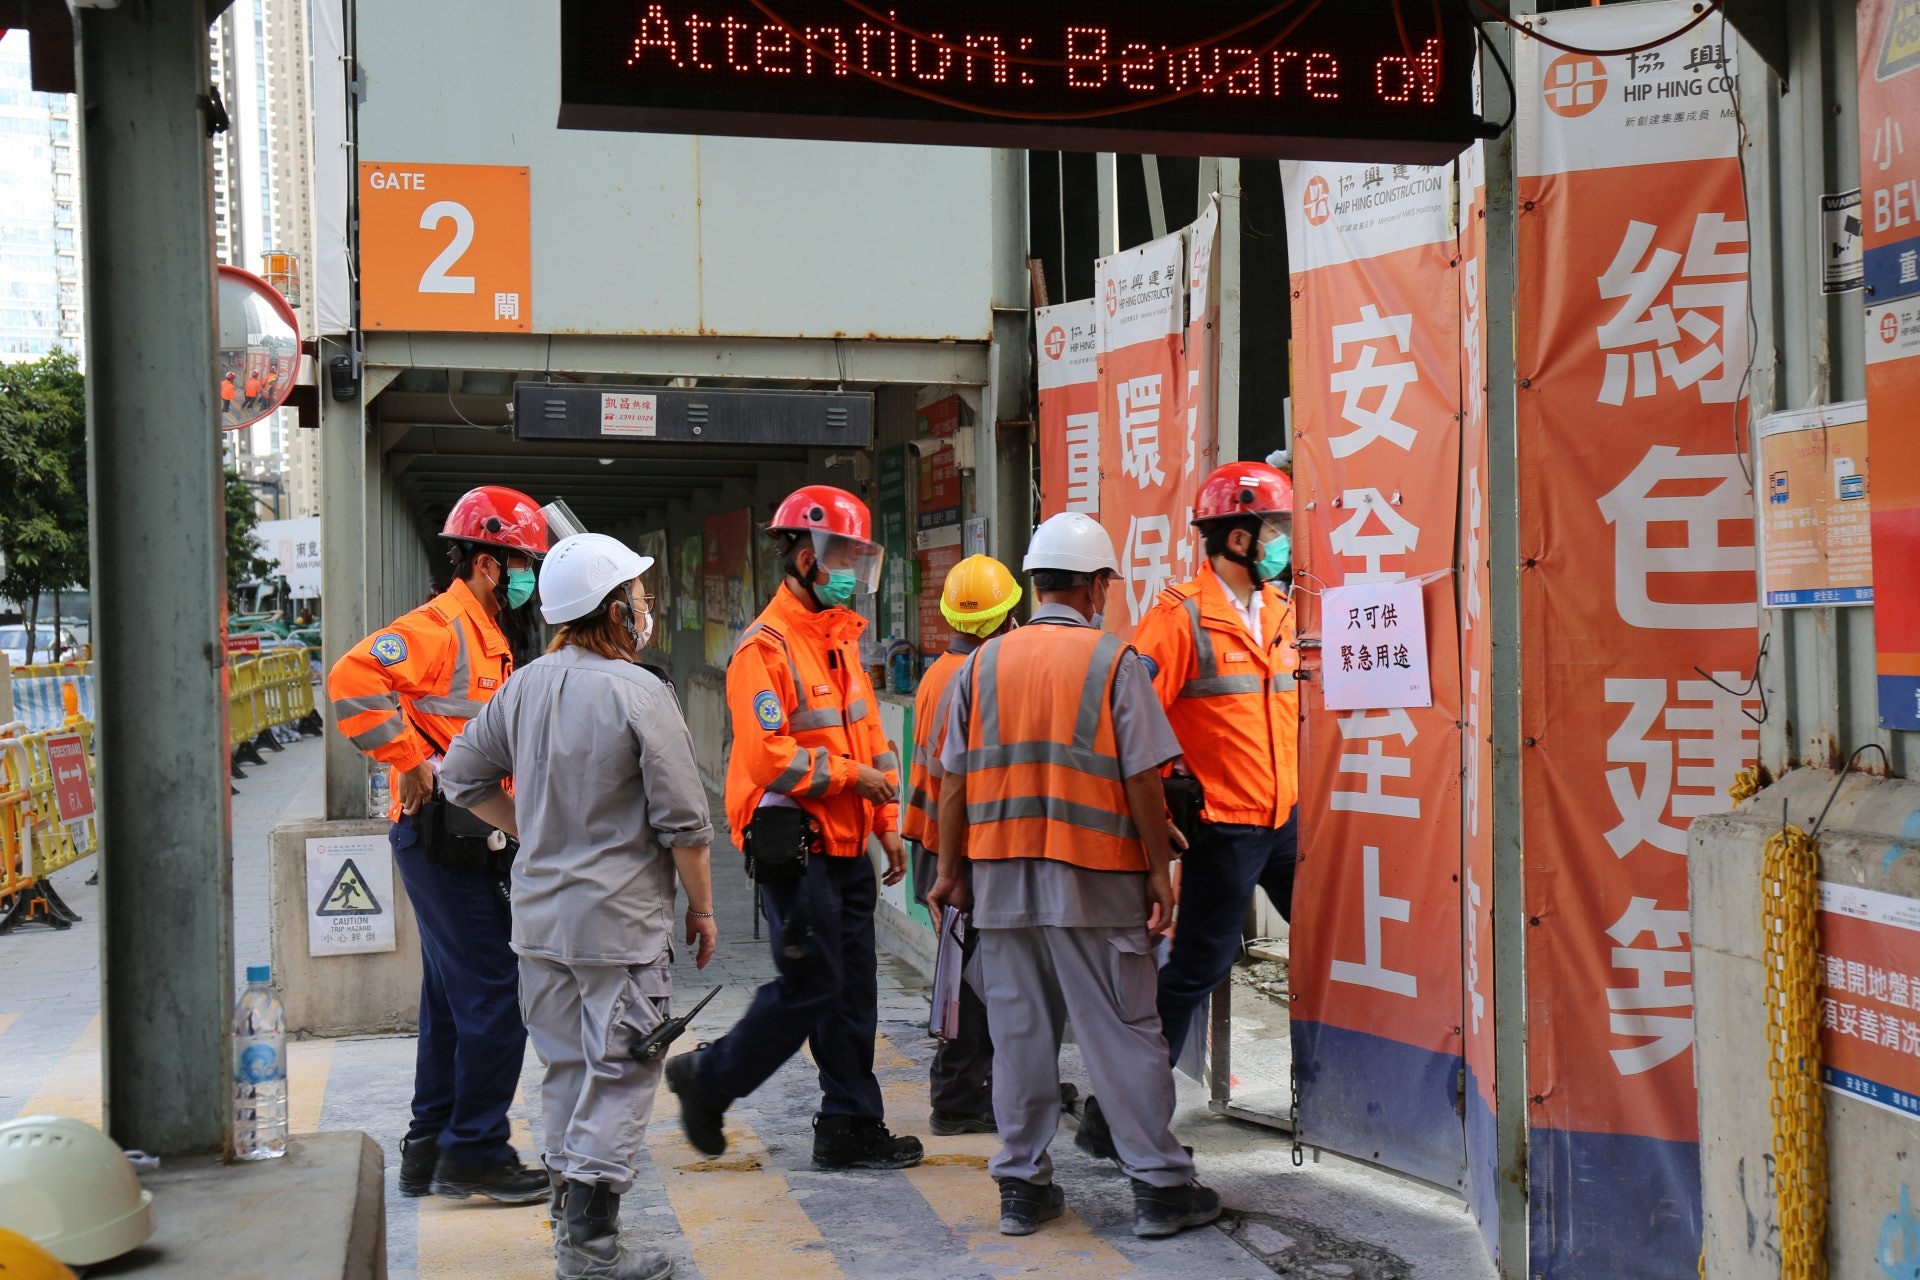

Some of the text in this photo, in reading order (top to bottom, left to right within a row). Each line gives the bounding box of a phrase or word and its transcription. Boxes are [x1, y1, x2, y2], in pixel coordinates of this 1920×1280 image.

[628, 5, 1033, 84] Attention:
[1067, 27, 1338, 98] Beware
[1625, 45, 1731, 80] 協興
[1624, 84, 1652, 102] HIP
[1657, 79, 1702, 99] HING
[370, 172, 426, 191] GATE
[1334, 176, 1442, 215] HIP HING CONSTRUCTION
[418, 200, 475, 294] 2
[495, 293, 519, 320] 閘
[1126, 294, 1137, 307] HING
[1070, 343, 1079, 353] HIP
[296, 561, 308, 569] NAN
[1347, 603, 1398, 630] 只可供
[1328, 304, 1419, 998] 安全至上
[1340, 643, 1411, 672] 緊急用途
[49, 742, 82, 758] PEDESTRIANS
[68, 791, 83, 811] 行人
[333, 917, 369, 926] CAUTION
[1846, 1077, 1878, 1098] 安全至上
